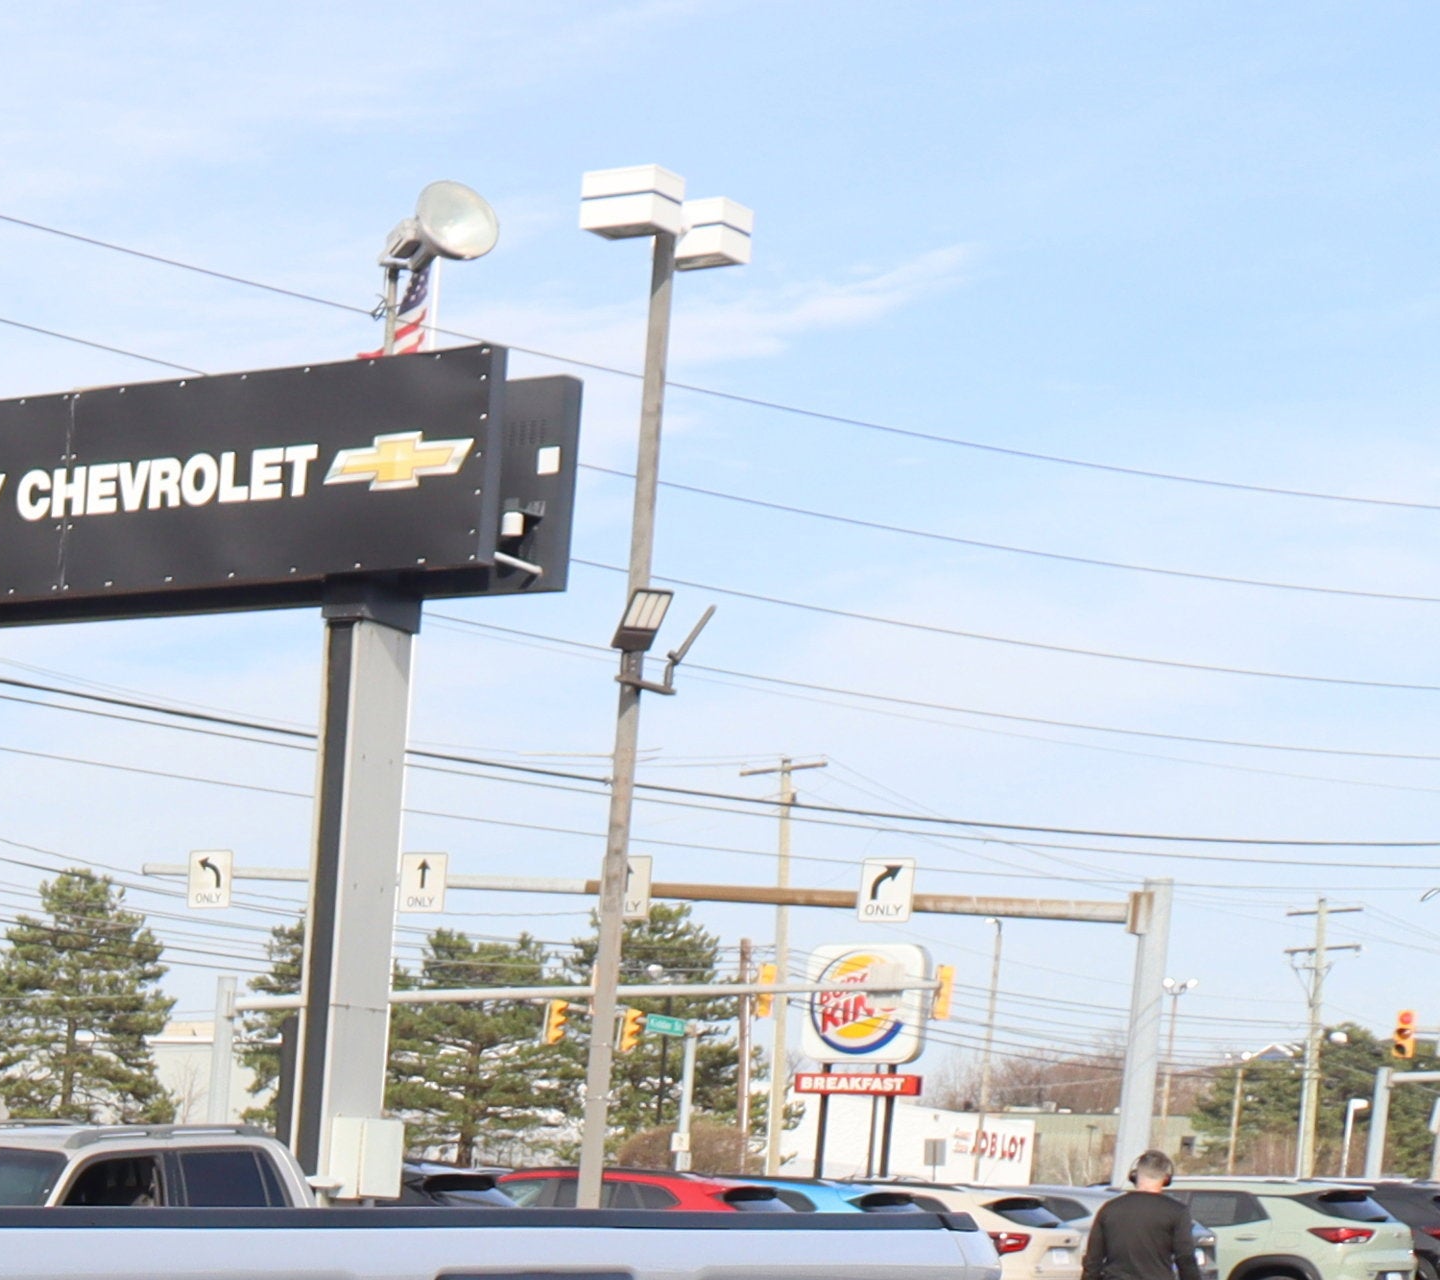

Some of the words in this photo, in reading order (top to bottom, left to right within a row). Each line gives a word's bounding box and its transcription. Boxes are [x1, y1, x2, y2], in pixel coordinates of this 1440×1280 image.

[16, 443, 319, 521] CHEVROLET
[195, 891, 222, 904] ONLY
[407, 896, 435, 907] ONLY
[625, 900, 642, 913] LY
[865, 903, 903, 916] ONLY
[800, 1076, 905, 1091] BREAKFAST
[970, 1129, 997, 1159] JOB
[1000, 1133, 1026, 1163] LOT
